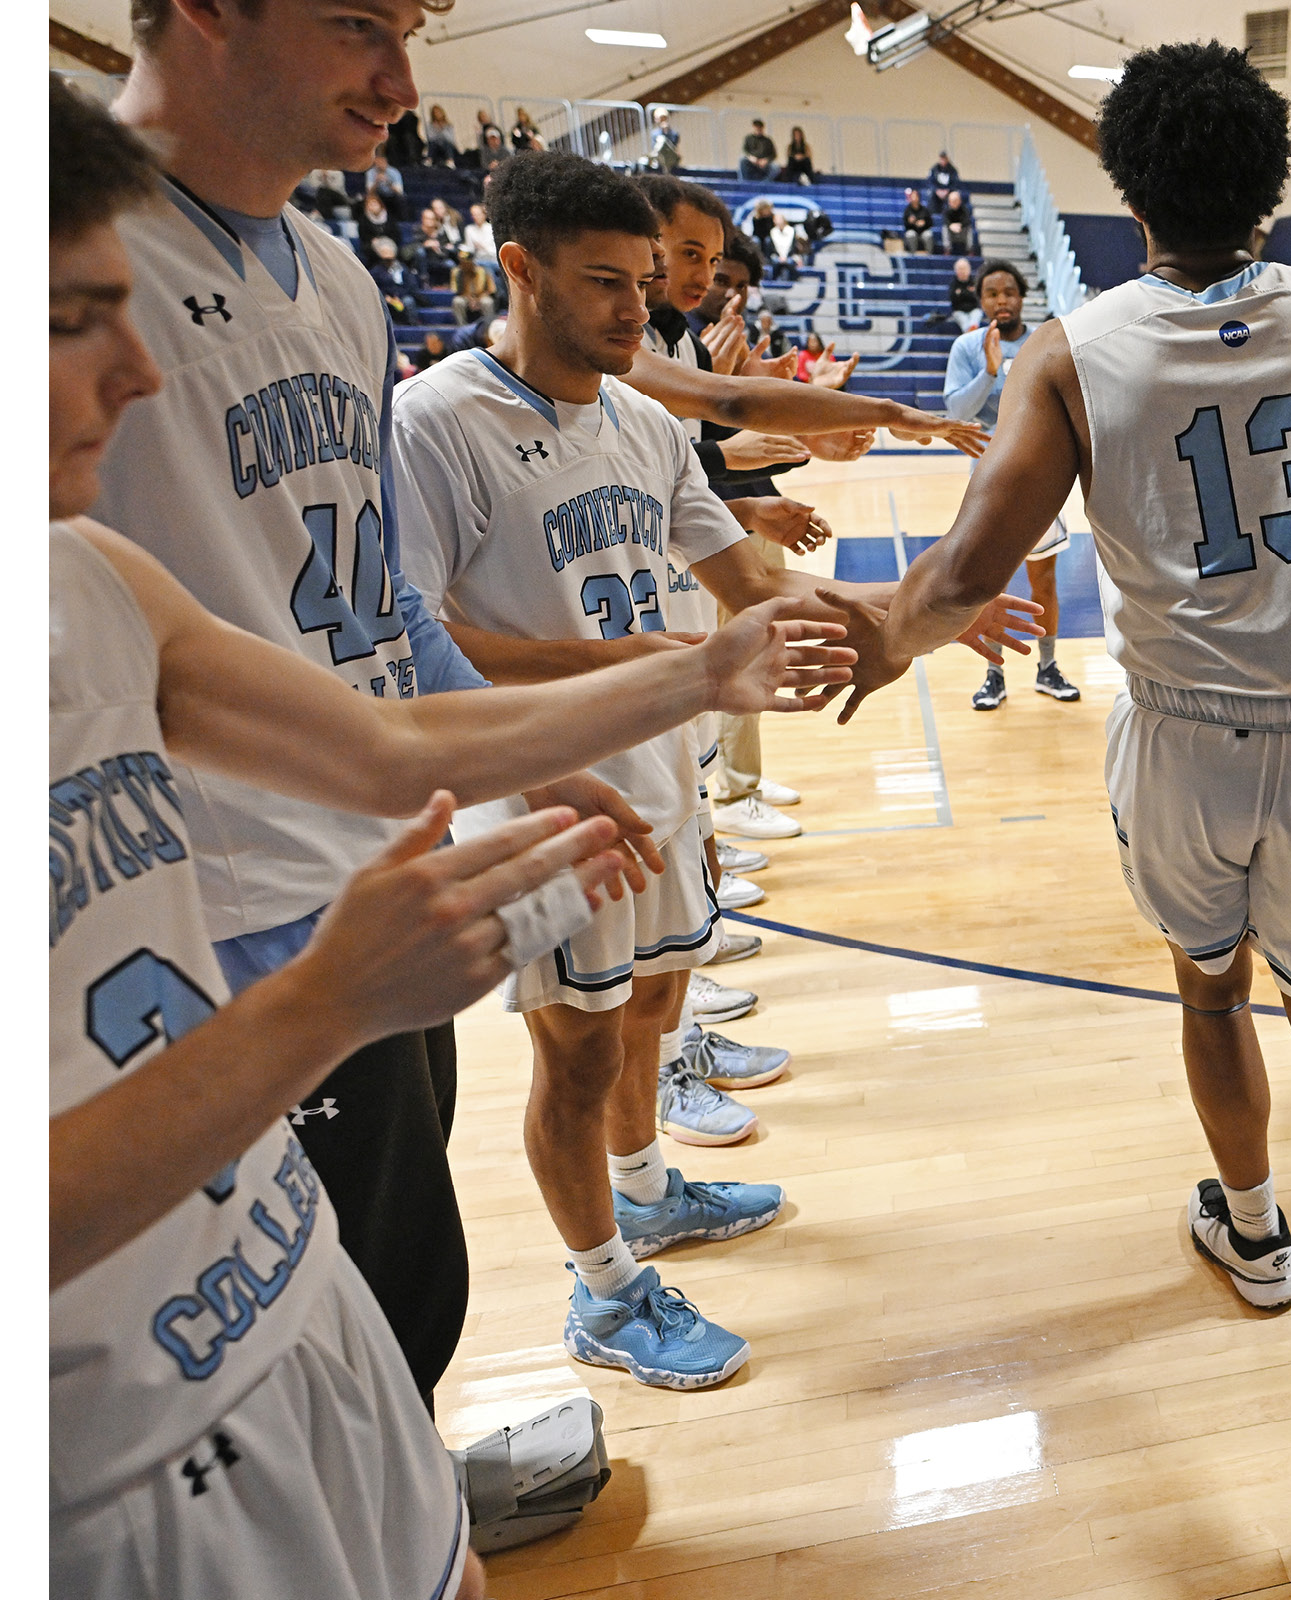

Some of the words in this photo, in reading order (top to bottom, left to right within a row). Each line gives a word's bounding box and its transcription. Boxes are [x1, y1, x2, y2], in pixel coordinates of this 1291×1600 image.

[1223, 329, 1249, 341] NCAA
[543, 484, 664, 573] CONNECTICUT
[291, 499, 406, 666] 40
